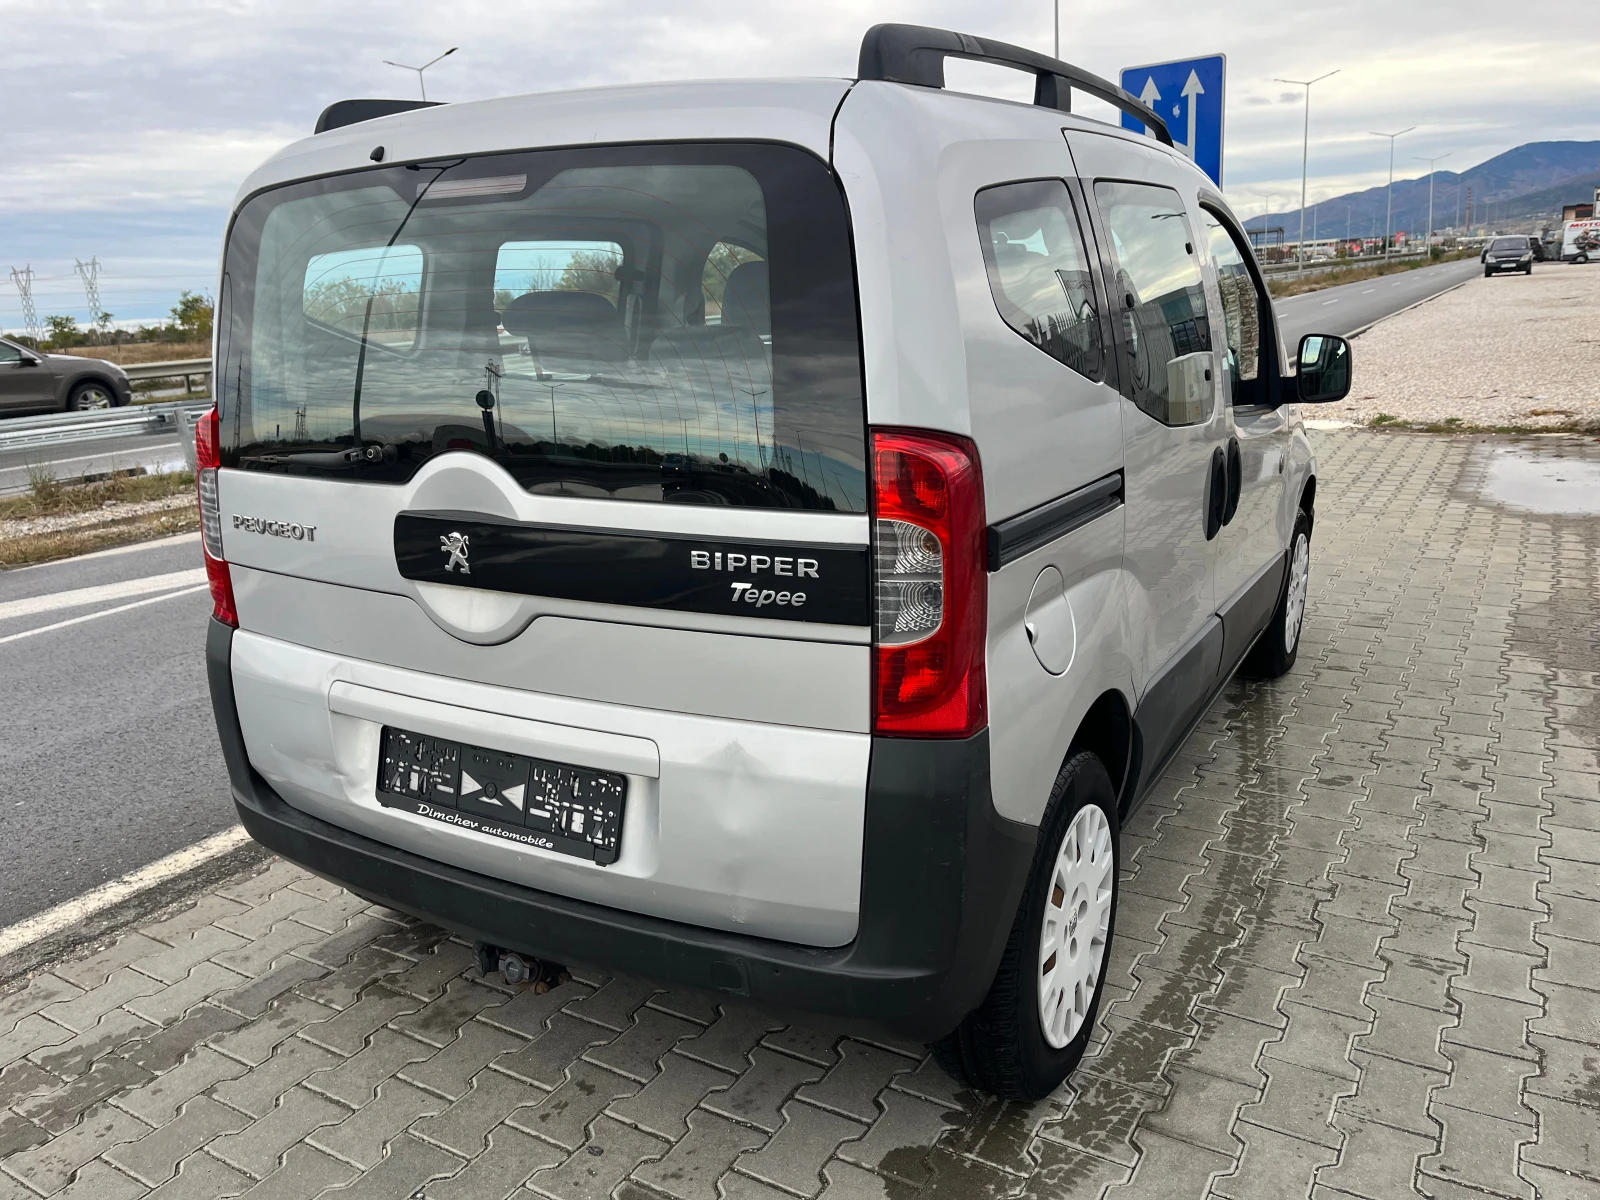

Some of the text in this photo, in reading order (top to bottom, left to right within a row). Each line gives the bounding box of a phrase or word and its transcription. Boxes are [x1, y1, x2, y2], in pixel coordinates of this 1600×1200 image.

[232, 513, 317, 541] PEUGEOT
[690, 550, 820, 578] BIPPER
[730, 582, 807, 608] Tepee
[417, 803, 554, 849] Dimchev automobile
